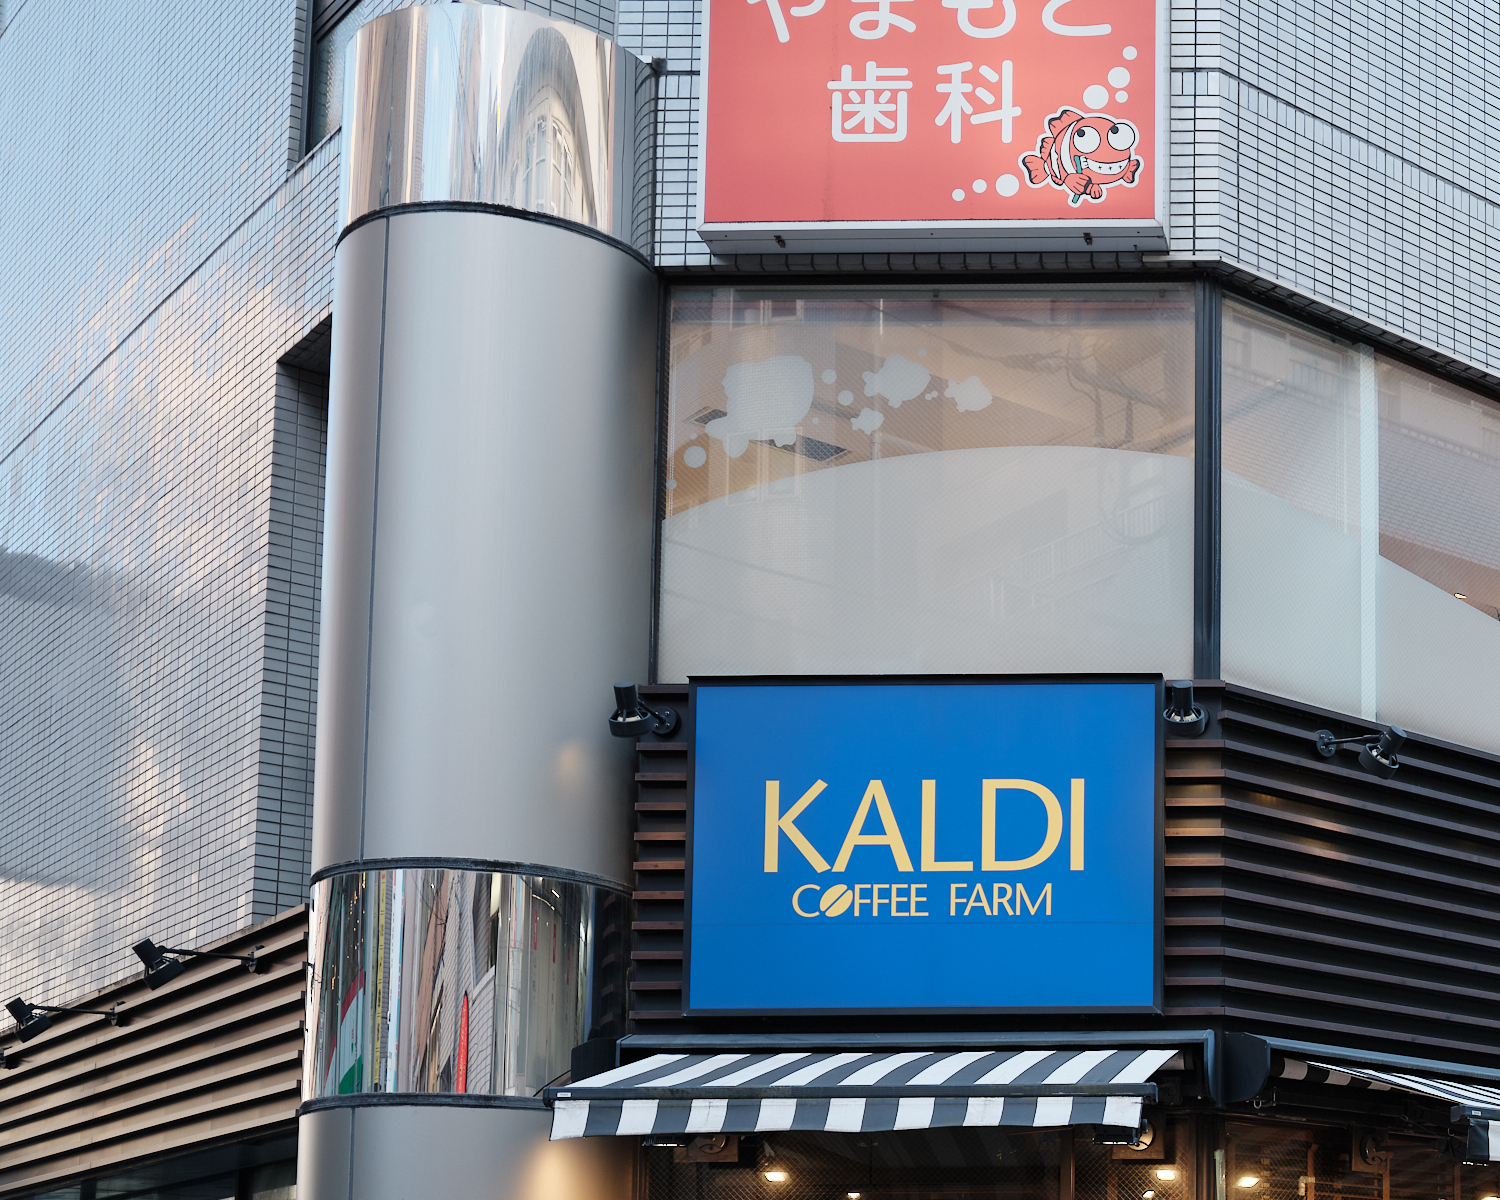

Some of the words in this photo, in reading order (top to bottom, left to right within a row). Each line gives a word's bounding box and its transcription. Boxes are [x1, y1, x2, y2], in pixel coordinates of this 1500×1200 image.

[827, 60, 1022, 144] 歯科
[763, 777, 1085, 873] KALDI
[792, 882, 929, 918] COFFEE
[949, 882, 1052, 917] FARM
